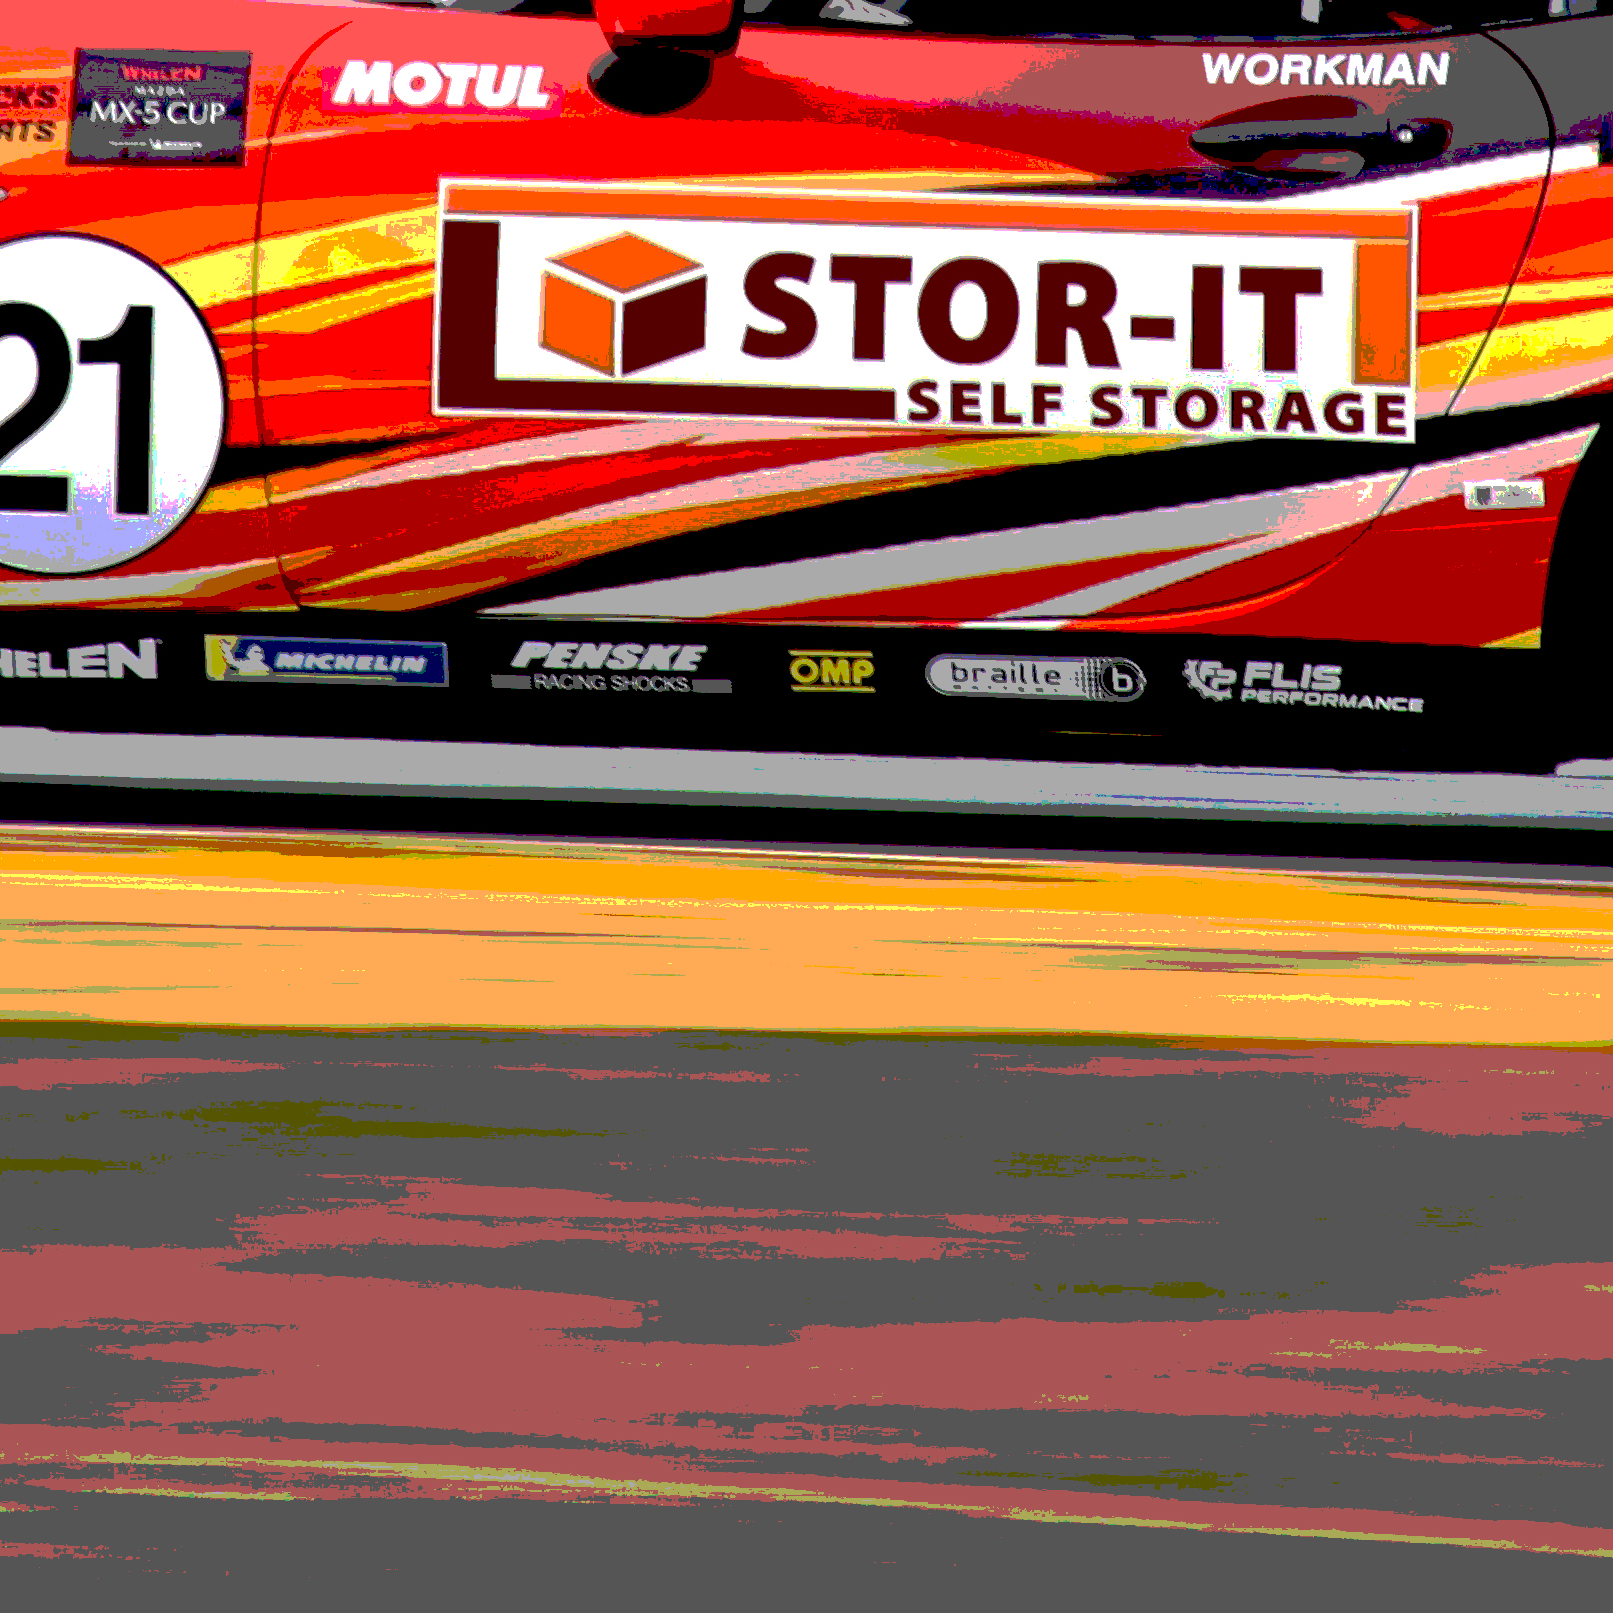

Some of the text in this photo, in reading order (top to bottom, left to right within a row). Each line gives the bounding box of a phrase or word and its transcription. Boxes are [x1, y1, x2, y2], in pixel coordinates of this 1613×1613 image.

[331, 61, 549, 108] MOTUL
[1201, 53, 1450, 86] WORKMAN
[90, 100, 226, 126] MX-5 CUP
[740, 250, 1325, 372] STOR-IT
[907, 380, 1409, 439] SELF STORAGE
[274, 651, 428, 674] MICHELIN
[510, 640, 709, 672] PENSKE
[790, 656, 874, 686] OMP
[534, 673, 691, 692] RACING SHOCKS
[950, 660, 1061, 686] braille
[1243, 660, 1343, 691] FLIS
[1240, 688, 1425, 714] PERFORMANCE
